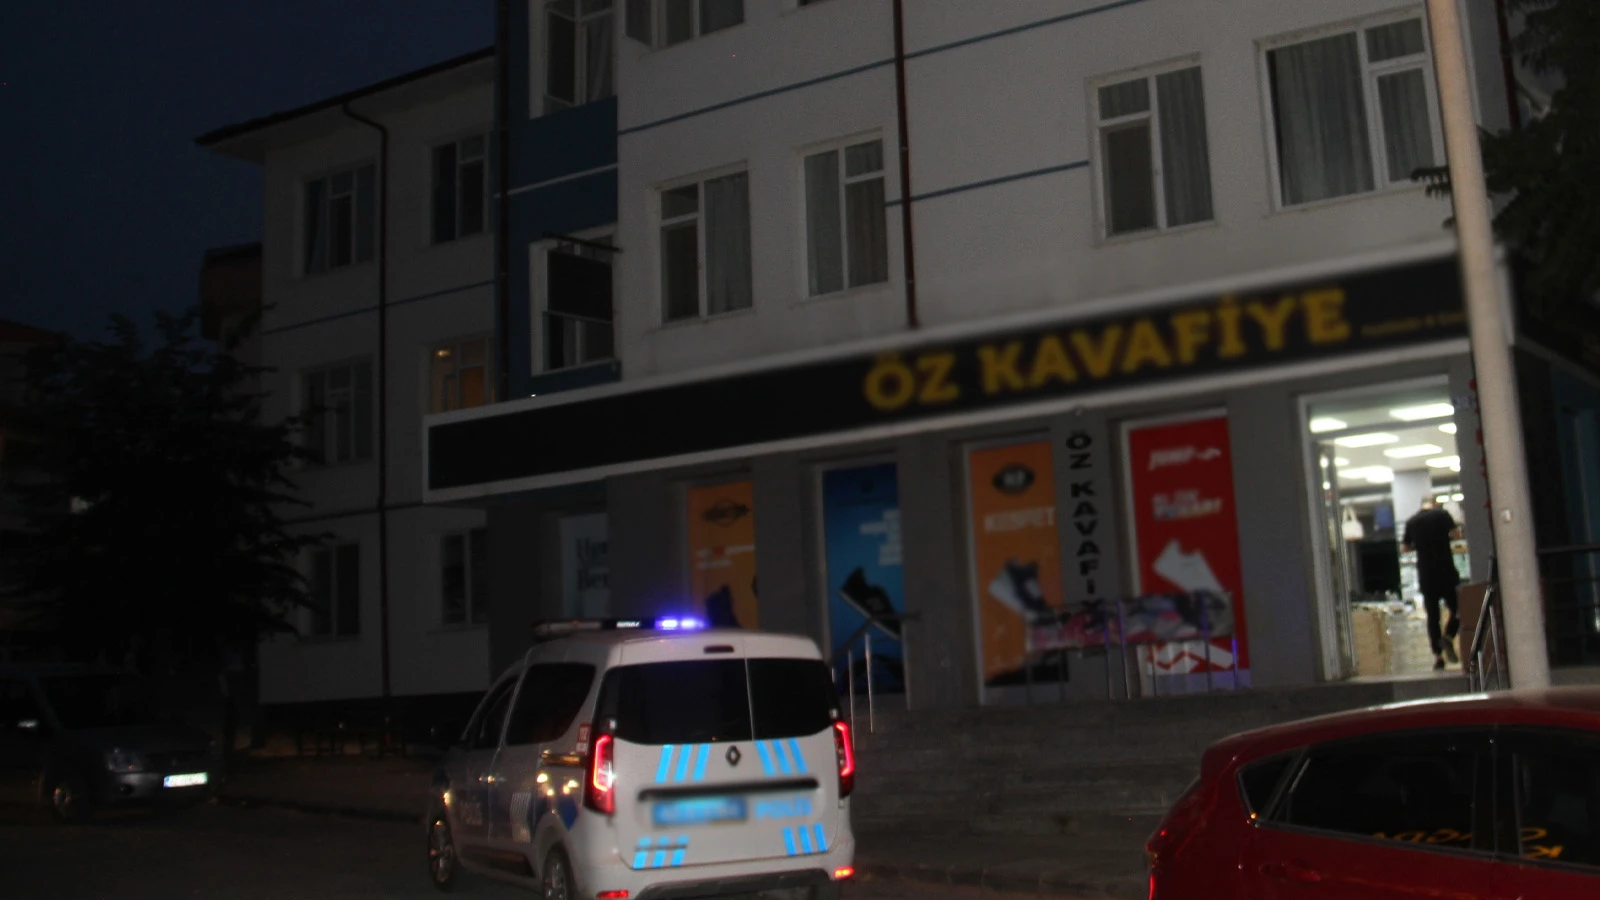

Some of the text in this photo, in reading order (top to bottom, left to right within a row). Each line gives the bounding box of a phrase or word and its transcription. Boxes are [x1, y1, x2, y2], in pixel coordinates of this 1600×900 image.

[862, 286, 1352, 412] ÖZ KAVAFİYE
[1065, 430, 1092, 470] ÖZ
